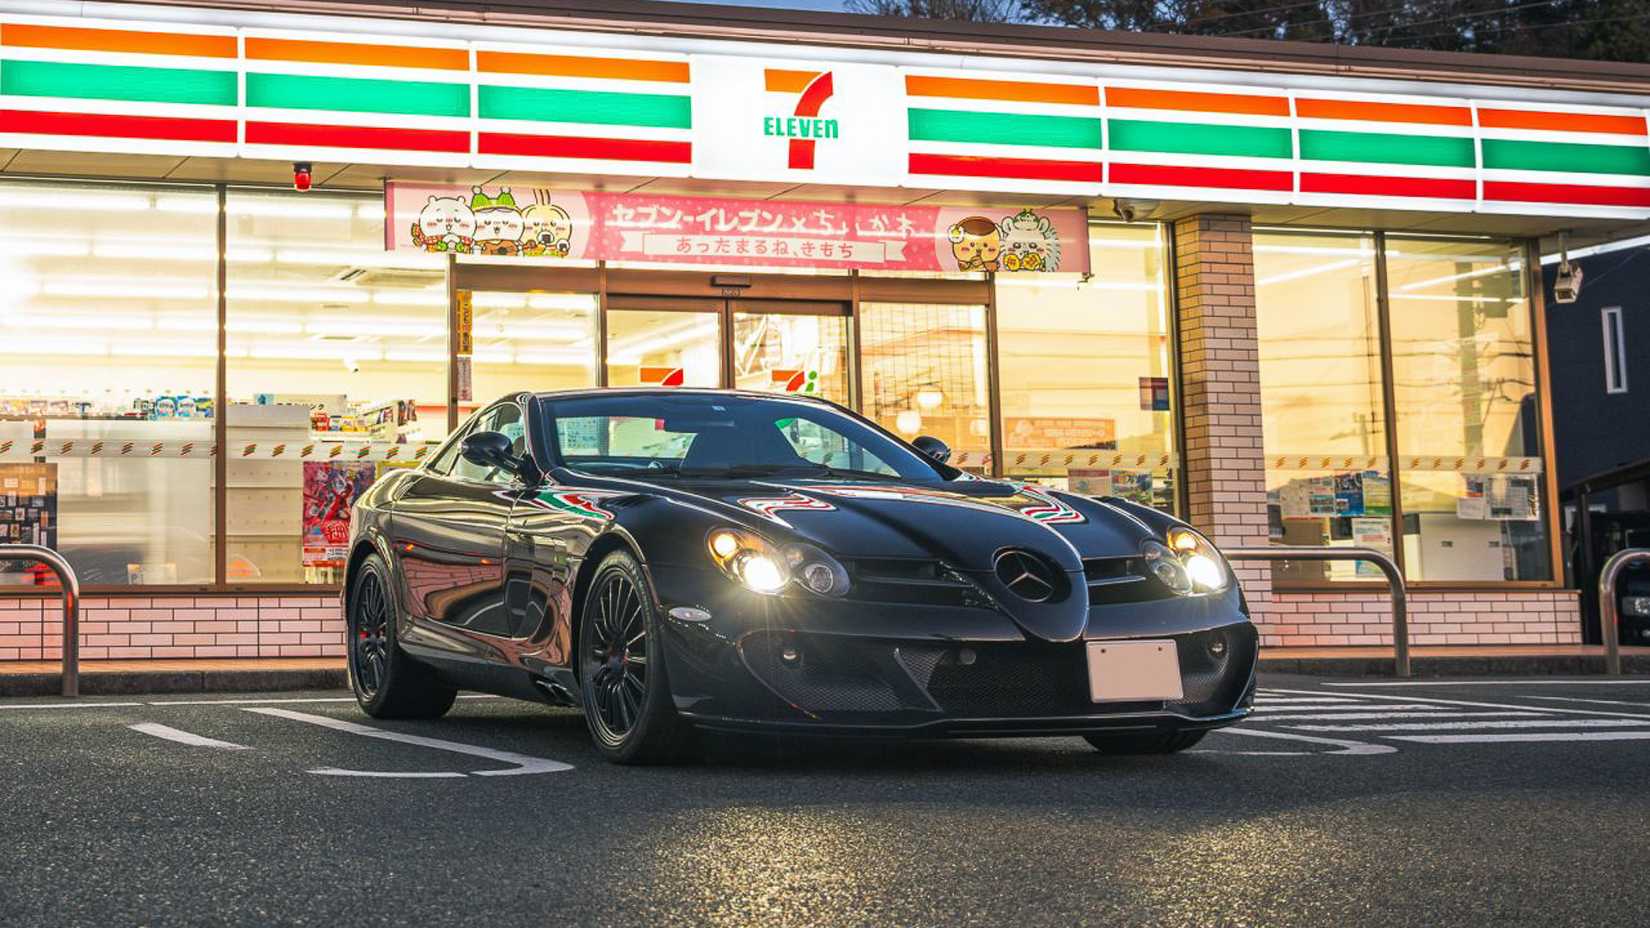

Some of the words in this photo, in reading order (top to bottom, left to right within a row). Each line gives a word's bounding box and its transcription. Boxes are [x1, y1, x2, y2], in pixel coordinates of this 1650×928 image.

[764, 69, 833, 169] 7
[676, 237, 853, 258] あったまるね、きもち
